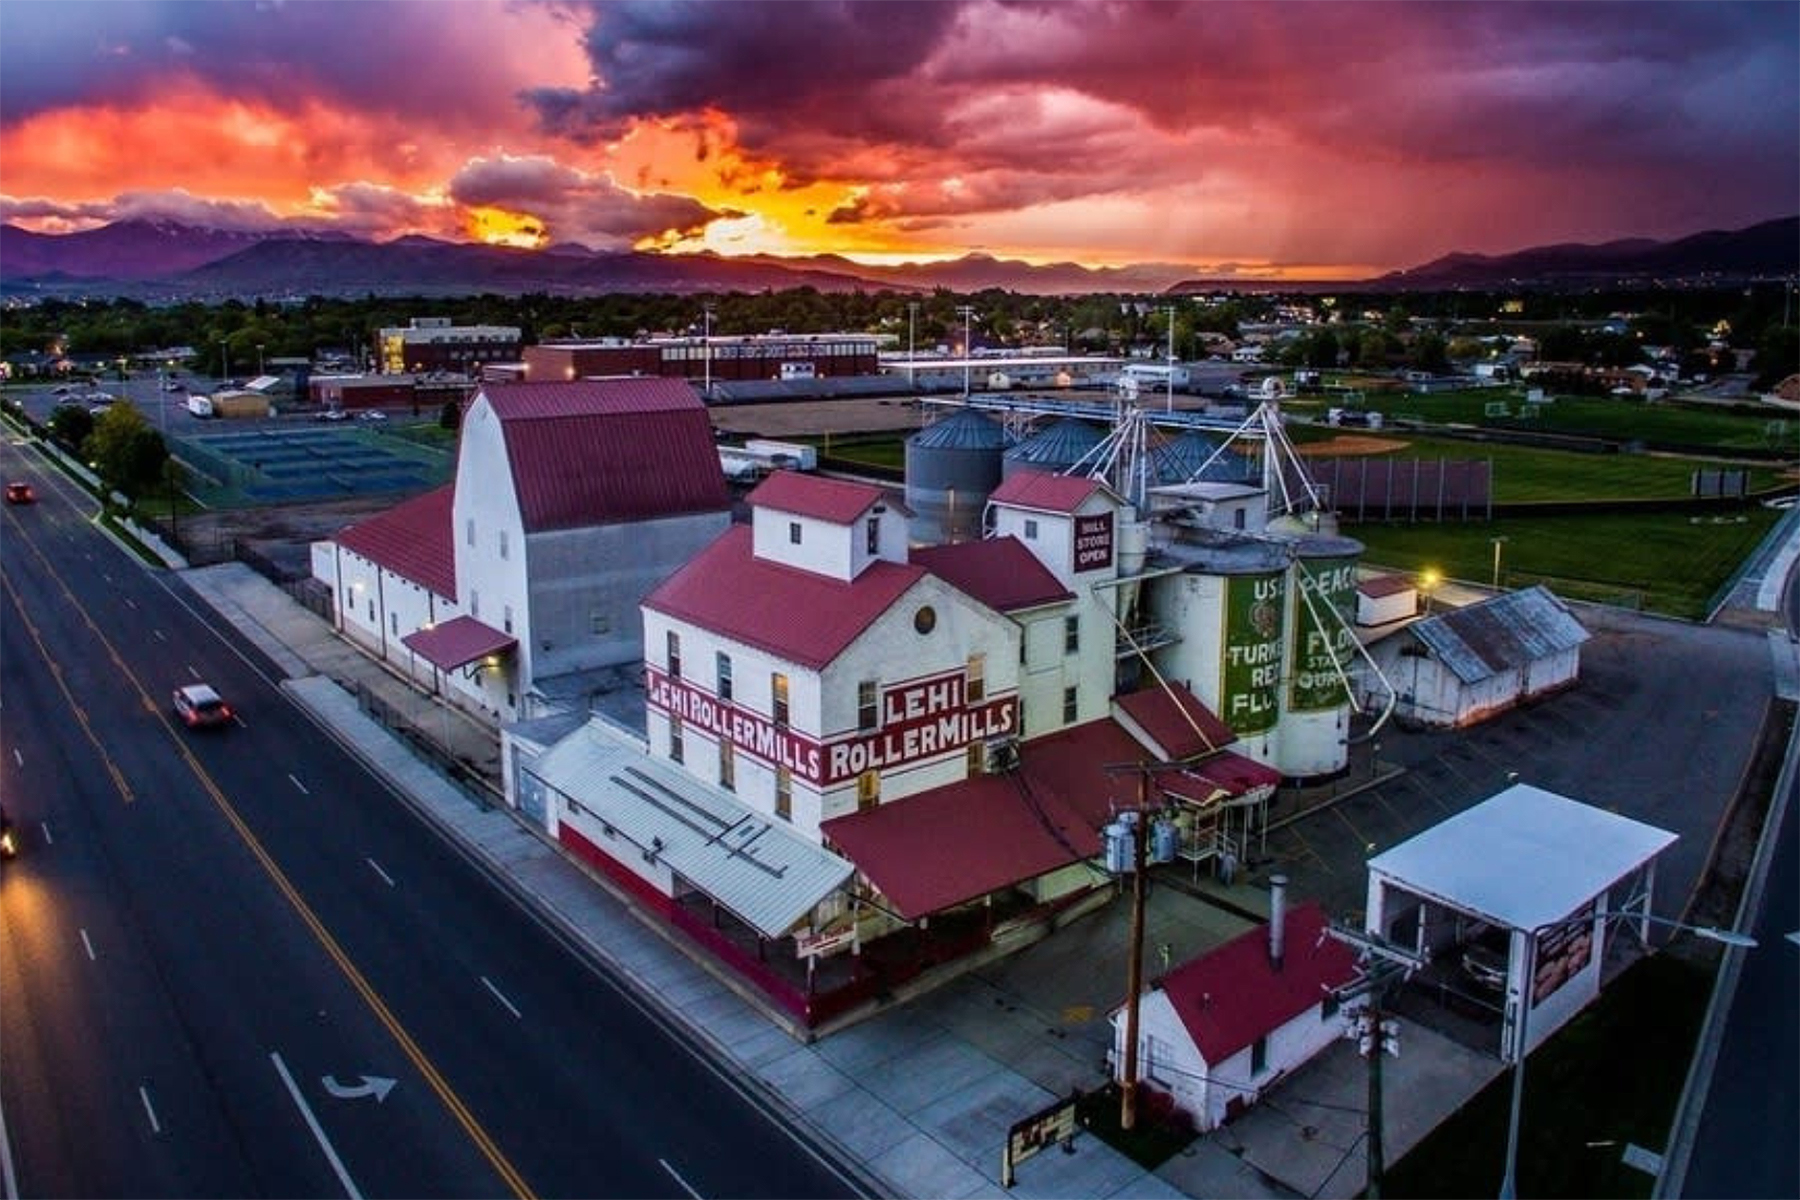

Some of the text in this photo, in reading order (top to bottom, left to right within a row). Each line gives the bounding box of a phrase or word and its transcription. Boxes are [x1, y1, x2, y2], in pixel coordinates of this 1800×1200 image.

[1077, 533, 1110, 550] STORE
[1079, 549, 1107, 564] OPEN
[1301, 565, 1355, 599] PEAC
[648, 672, 688, 716] LEHI
[886, 679, 960, 724] LEHI
